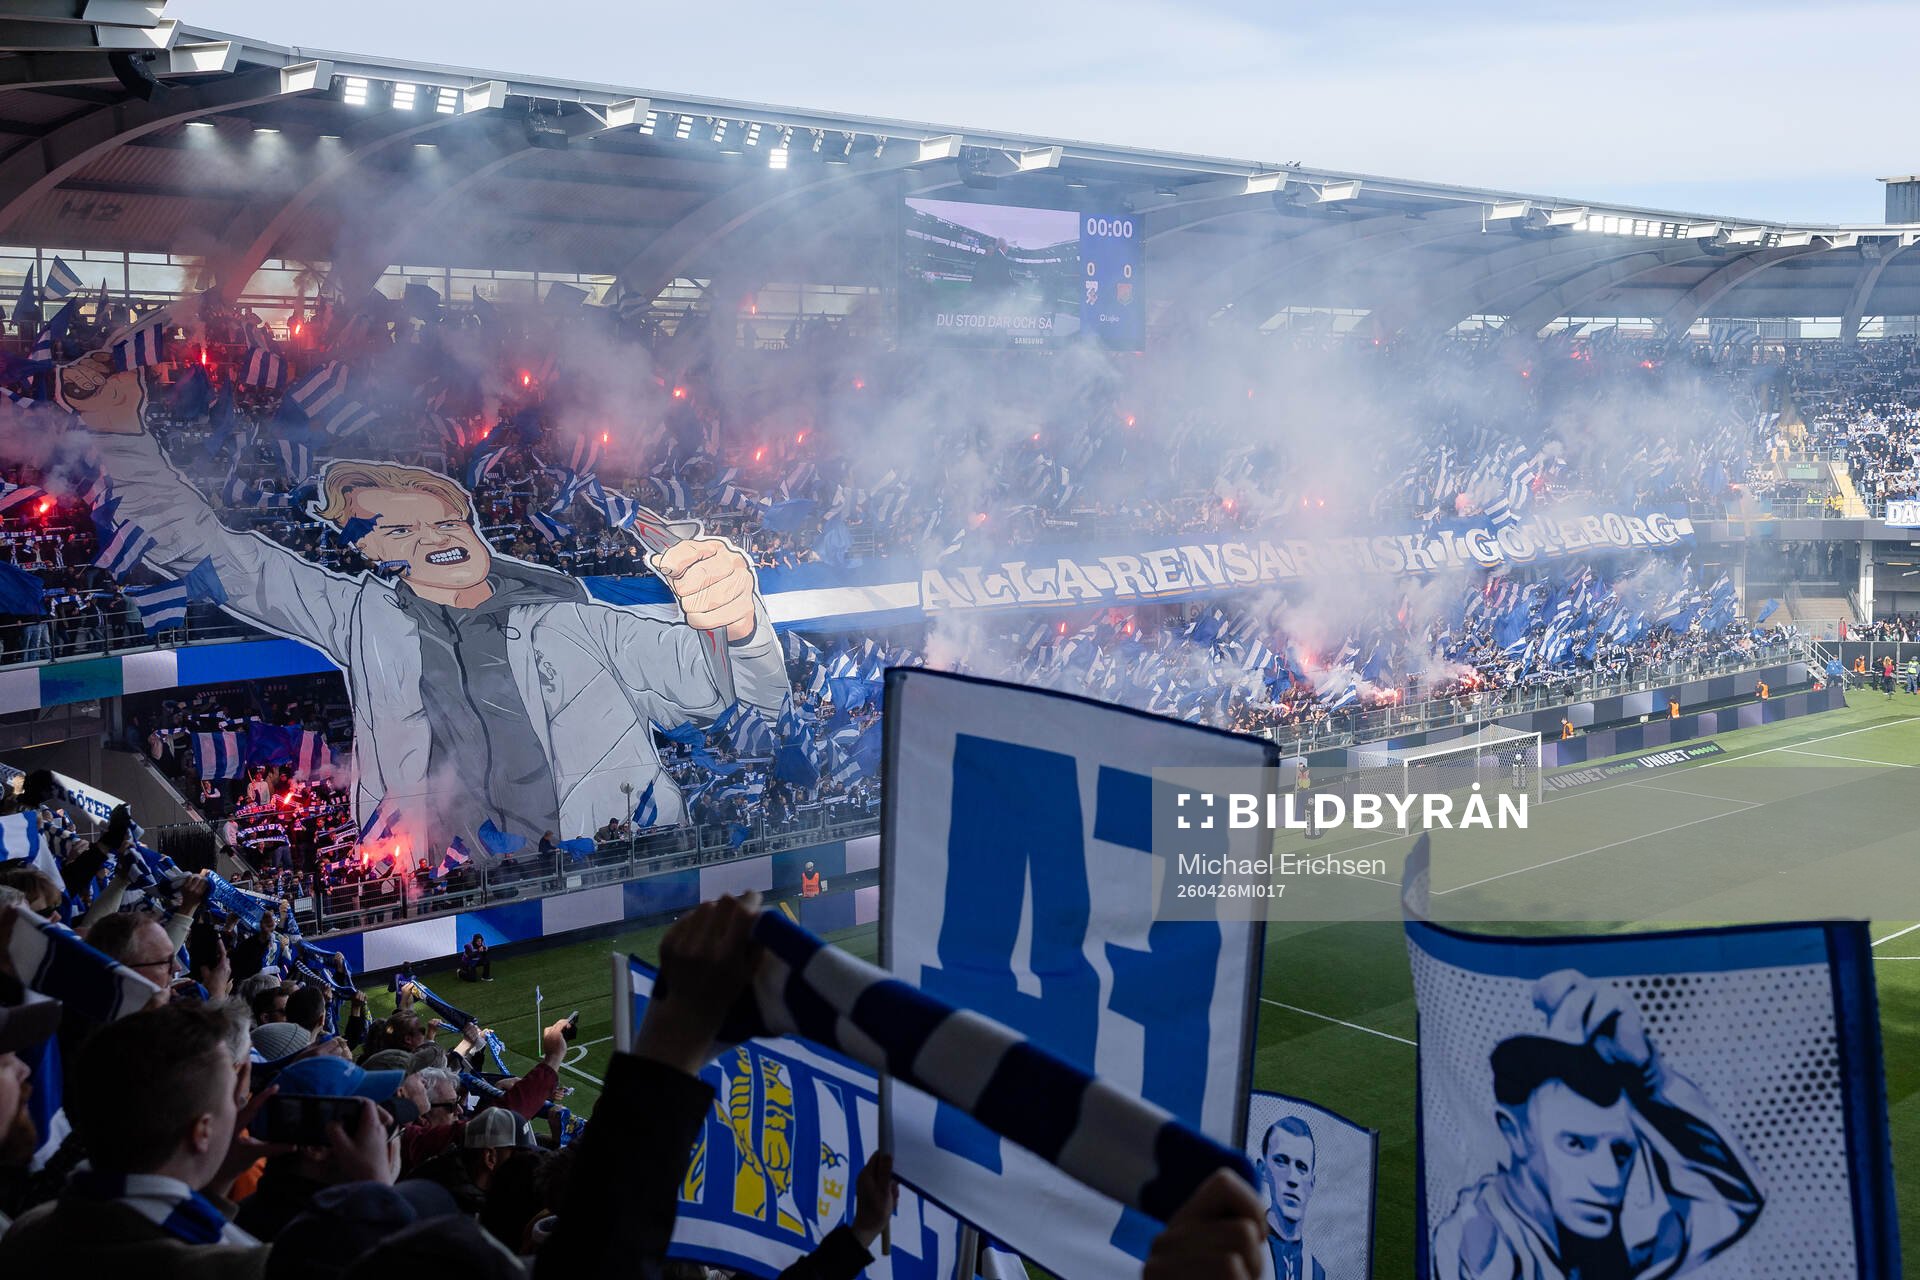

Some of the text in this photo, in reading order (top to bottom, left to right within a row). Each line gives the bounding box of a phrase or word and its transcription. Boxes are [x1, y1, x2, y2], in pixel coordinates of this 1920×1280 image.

[1087, 217, 1133, 238] 00:00
[1087, 262, 1096, 277] 0
[1123, 264, 1132, 279] 0
[936, 313, 954, 328] DU
[955, 313, 986, 329] STOD
[1013, 315, 1037, 329] OCH
[921, 558, 1101, 611] ALLA
[1638, 749, 1692, 769] UNIBET
[1550, 767, 1608, 790] UNIBET
